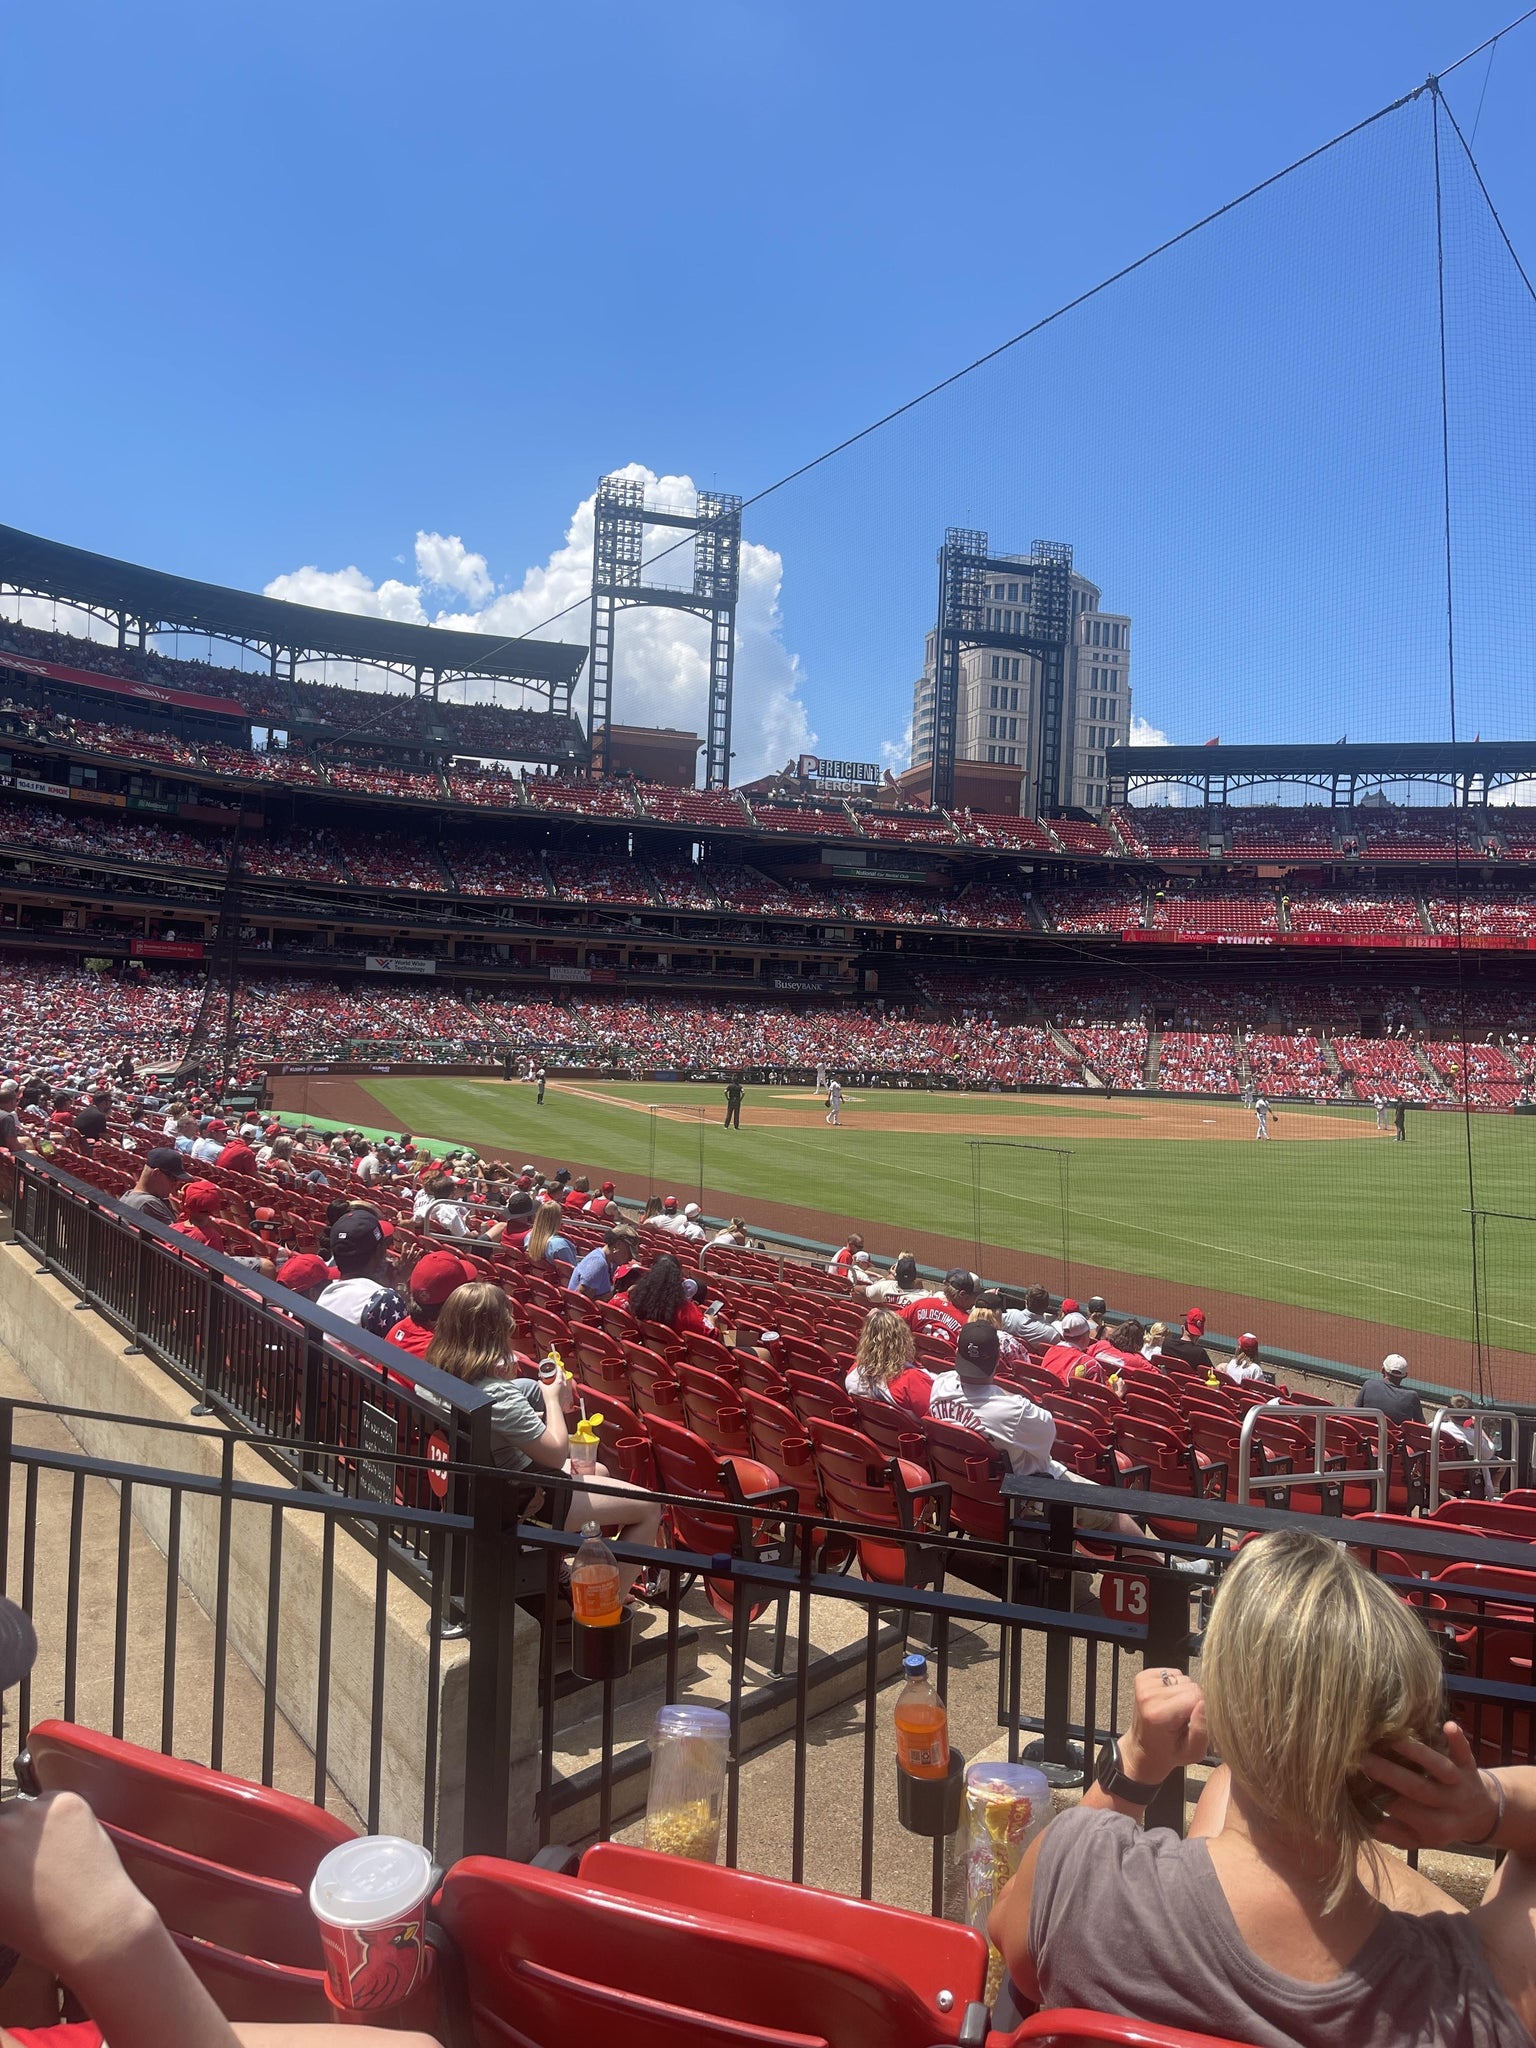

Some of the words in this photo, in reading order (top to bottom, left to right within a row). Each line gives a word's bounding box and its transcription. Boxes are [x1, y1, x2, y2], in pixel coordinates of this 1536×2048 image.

[801, 755, 879, 781] PERFICIENT
[35, 784, 46, 792] FM
[816, 780, 861, 792] PERCH
[855, 869, 876, 877] National
[395, 965, 426, 973] Technology
[917, 1308, 962, 1332] GOLDSCHMIDT
[930, 1400, 985, 1433] ETHERHO
[1113, 1578, 1147, 1615] 13
